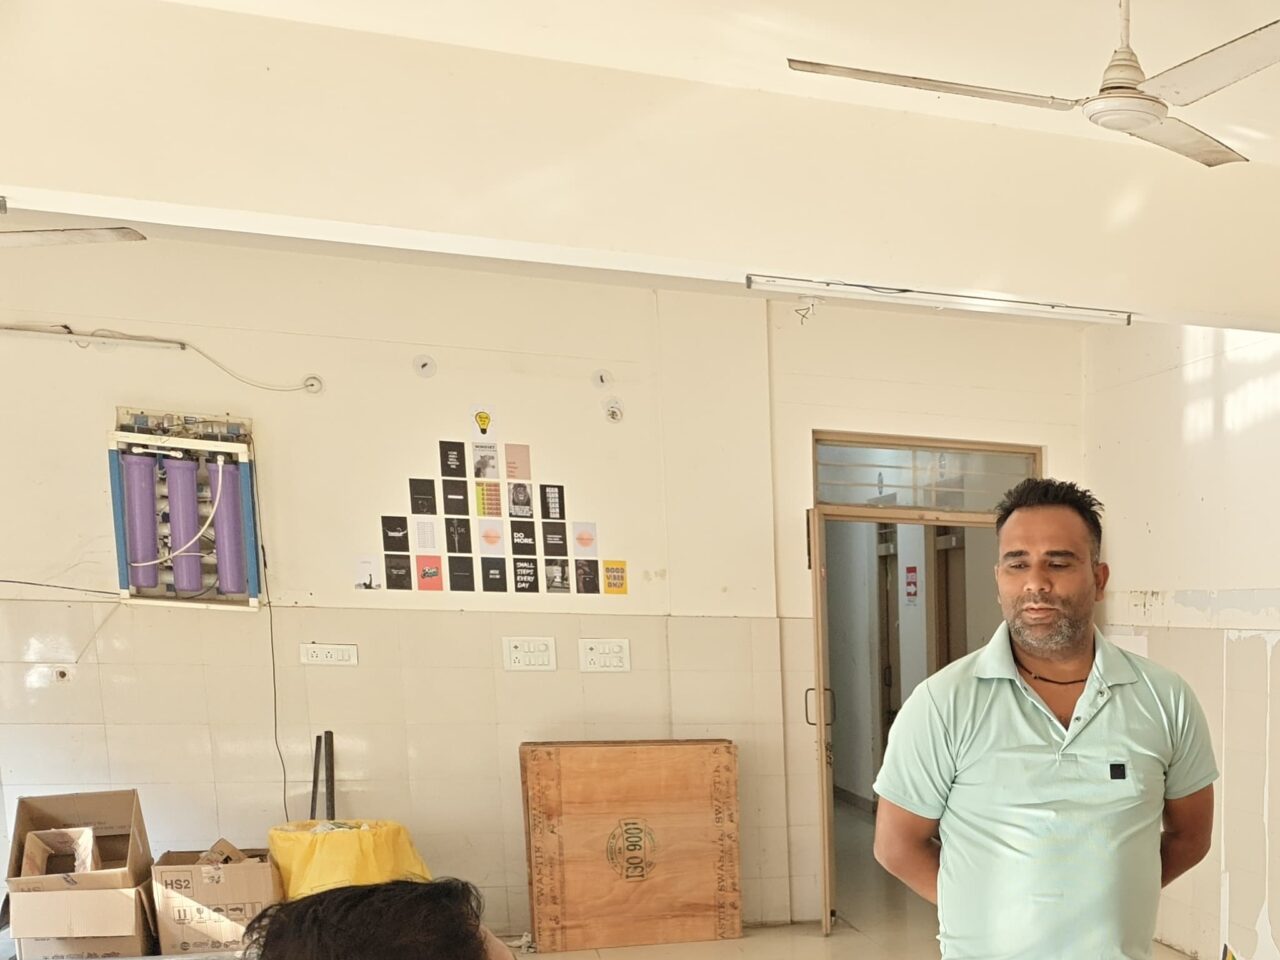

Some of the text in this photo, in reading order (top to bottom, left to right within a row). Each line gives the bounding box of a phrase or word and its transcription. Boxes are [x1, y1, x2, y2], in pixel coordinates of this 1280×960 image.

[624, 821, 645, 880] ISO 9001
[164, 879, 191, 890] HS2
